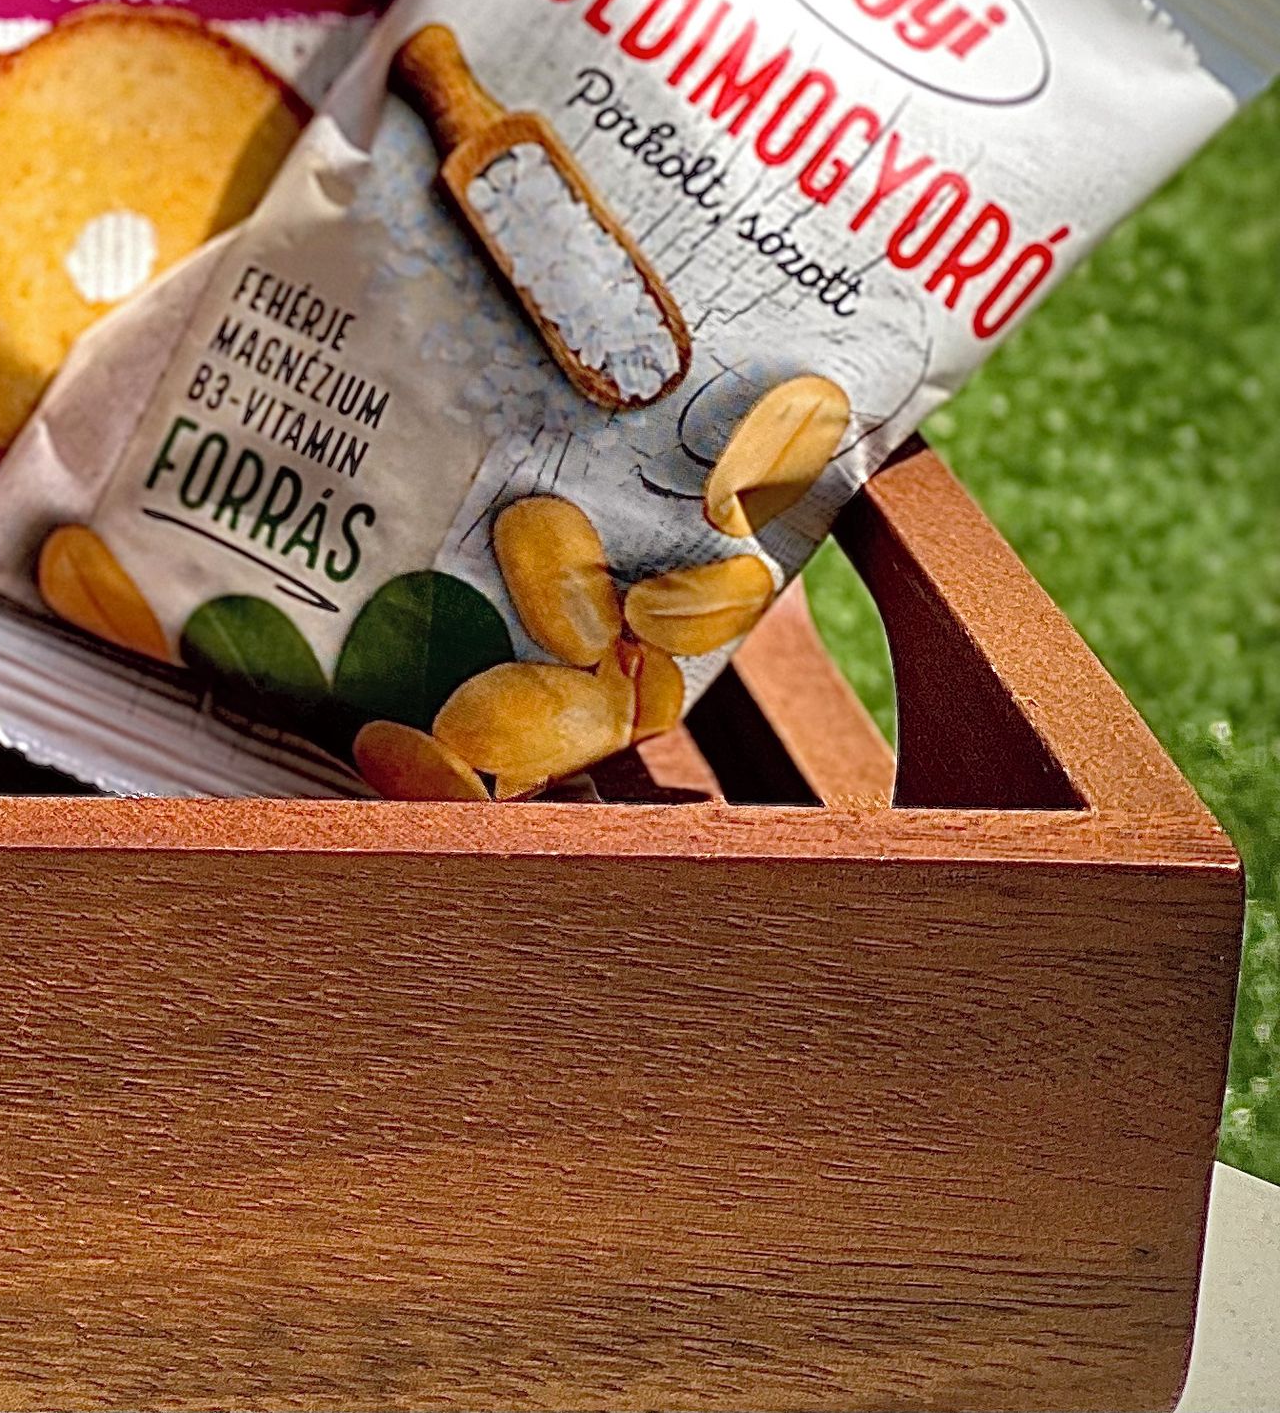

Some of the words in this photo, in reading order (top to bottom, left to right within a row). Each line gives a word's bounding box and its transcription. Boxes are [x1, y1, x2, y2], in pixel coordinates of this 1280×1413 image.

[566, 66, 728, 227] Pörkölt,
[739, 209, 863, 318] sózott
[230, 265, 357, 355] FEHÉRJE
[186, 364, 371, 479] B3-VITAMIN
[211, 316, 391, 430] MAGNÉZIUM
[144, 415, 376, 584] FORRÁS
